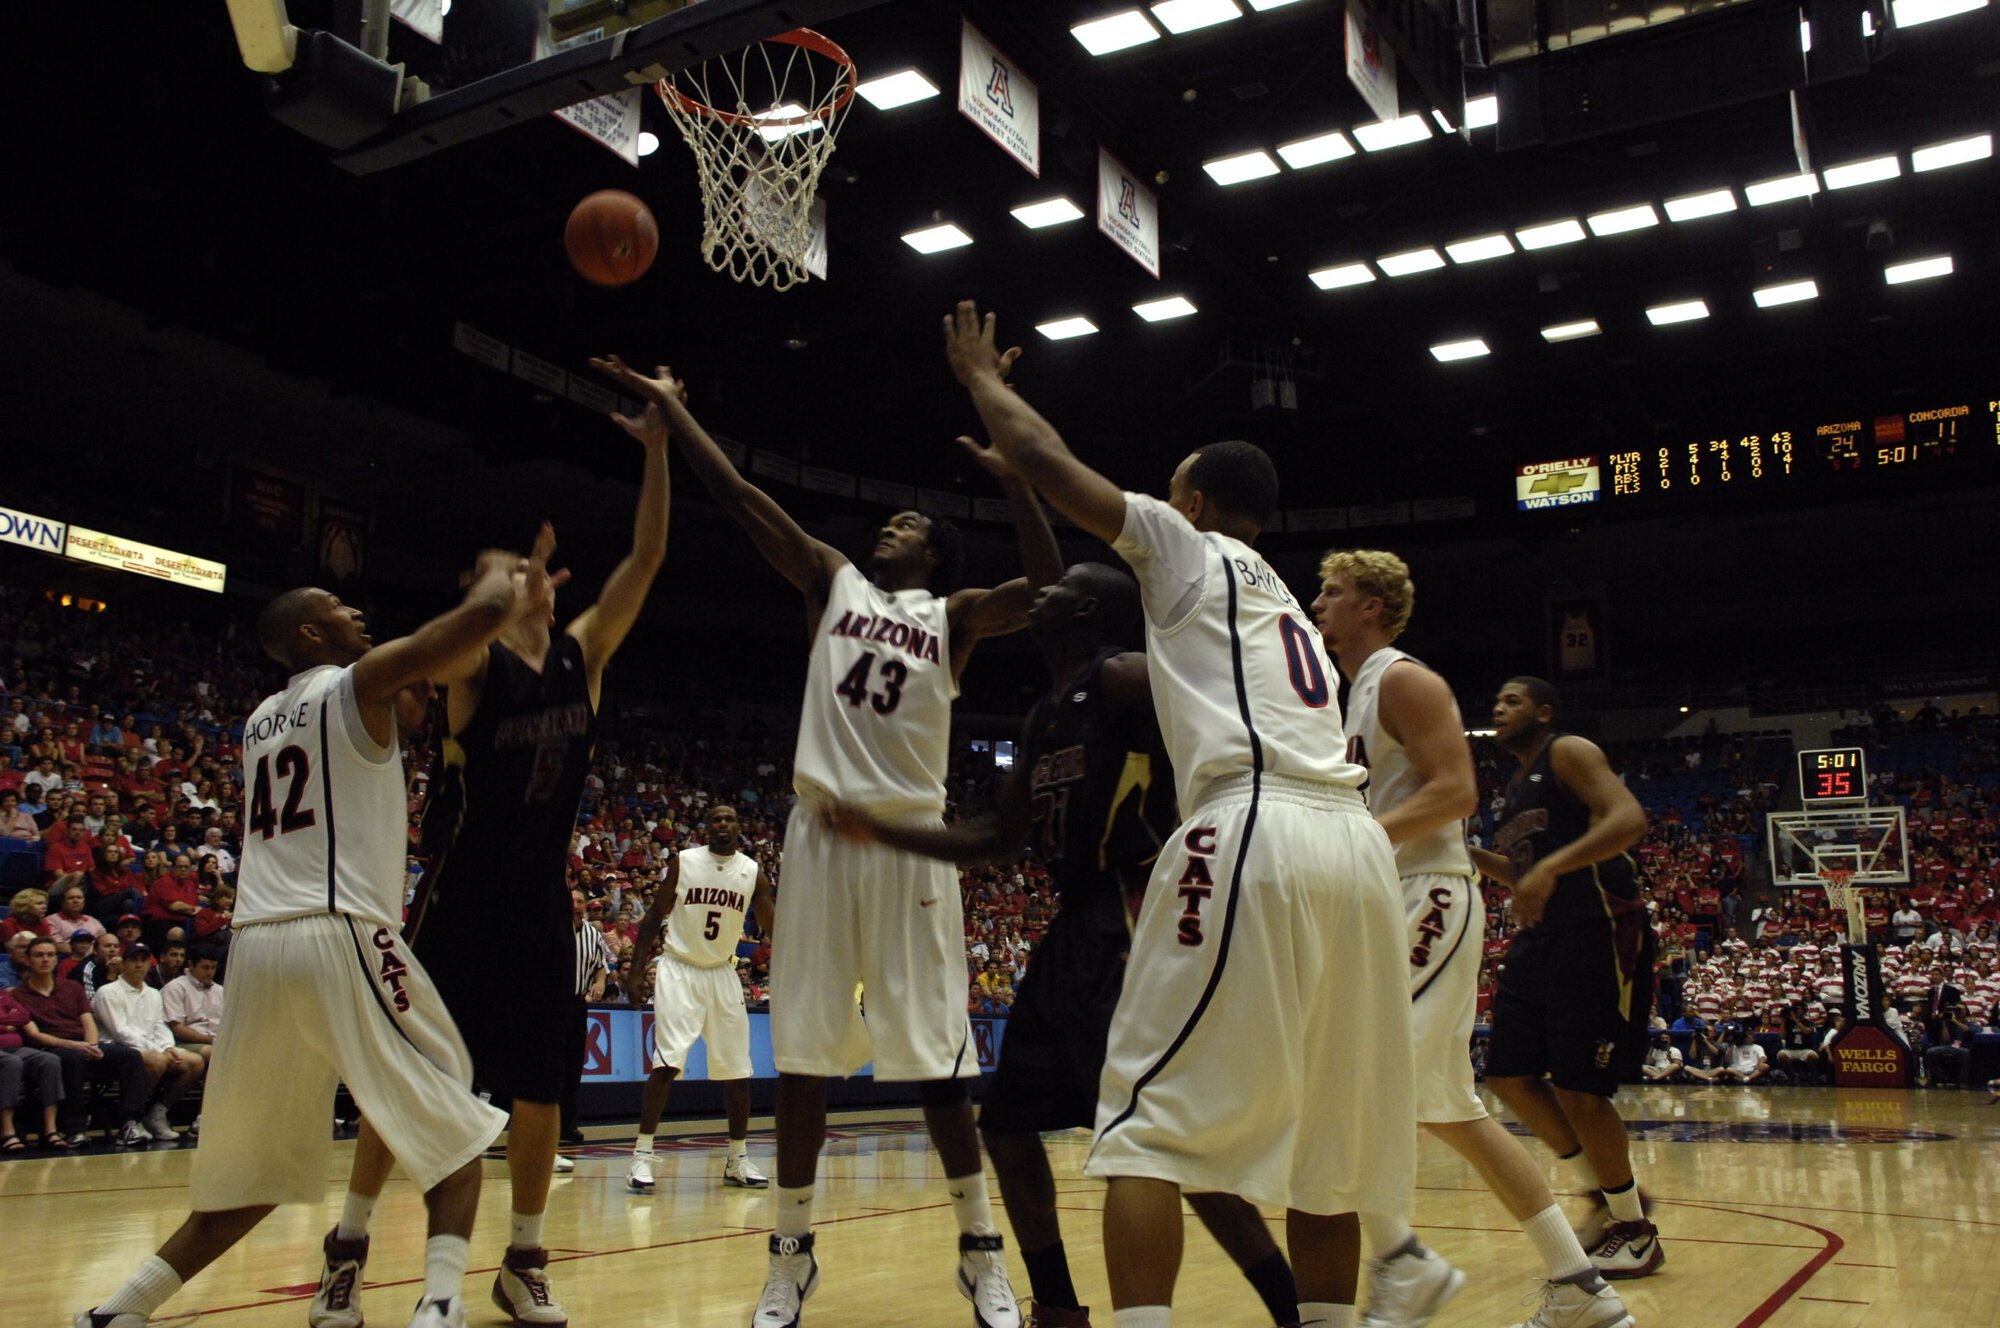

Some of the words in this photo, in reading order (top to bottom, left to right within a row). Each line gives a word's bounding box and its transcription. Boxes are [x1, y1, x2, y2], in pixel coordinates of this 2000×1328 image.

[983, 115, 1005, 139] SWEET
[1007, 136, 1033, 164] SIXTEEN
[1909, 405, 1970, 423] CONCORDIA
[1816, 420, 1861, 436] ARIZONA
[1939, 420, 1956, 438] 11
[1609, 451, 1641, 465] PLYR
[1659, 447, 1669, 458] 0
[1688, 443, 1699, 455] 5
[1709, 440, 1729, 452] 34
[1740, 435, 1761, 448] 42
[1771, 431, 1792, 444] 43
[1831, 435, 1854, 452] 24
[1877, 445, 1918, 465] 5:01
[1523, 457, 1591, 476] O'RIELLY
[1614, 473, 1640, 486] RBS
[1751, 456, 1761, 468] 0
[1783, 452, 1793, 464] 4
[1615, 462, 1638, 475] PTS
[1660, 458, 1670, 469] 2
[1689, 454, 1699, 465] 4
[1751, 446, 1761, 458] 2
[1660, 478, 1670, 489] 0
[1690, 474, 1700, 486] 0
[1721, 470, 1731, 482] 0
[1752, 466, 1762, 478] 0
[1525, 491, 1595, 510] WATSON
[69, 535, 105, 552] DESERT
[155, 556, 188, 573] DESERT
[829, 610, 940, 667] ARIZONA
[1567, 633, 1588, 647] 32
[1279, 613, 1329, 708] 0
[836, 651, 908, 716] 43
[1818, 753, 1856, 768] 5:01
[250, 744, 316, 841] 42
[1817, 772, 1850, 795] 35
[1177, 827, 1216, 947] CATS
[684, 887, 745, 913] ARIZONA
[704, 911, 722, 941] 5
[1410, 887, 1452, 968] CATS
[373, 927, 410, 1013] CATS
[1851, 949, 1871, 1020] ARIZONA
[1838, 1049, 1897, 1060] WELLS
[1841, 1062, 1897, 1073] FARGO
